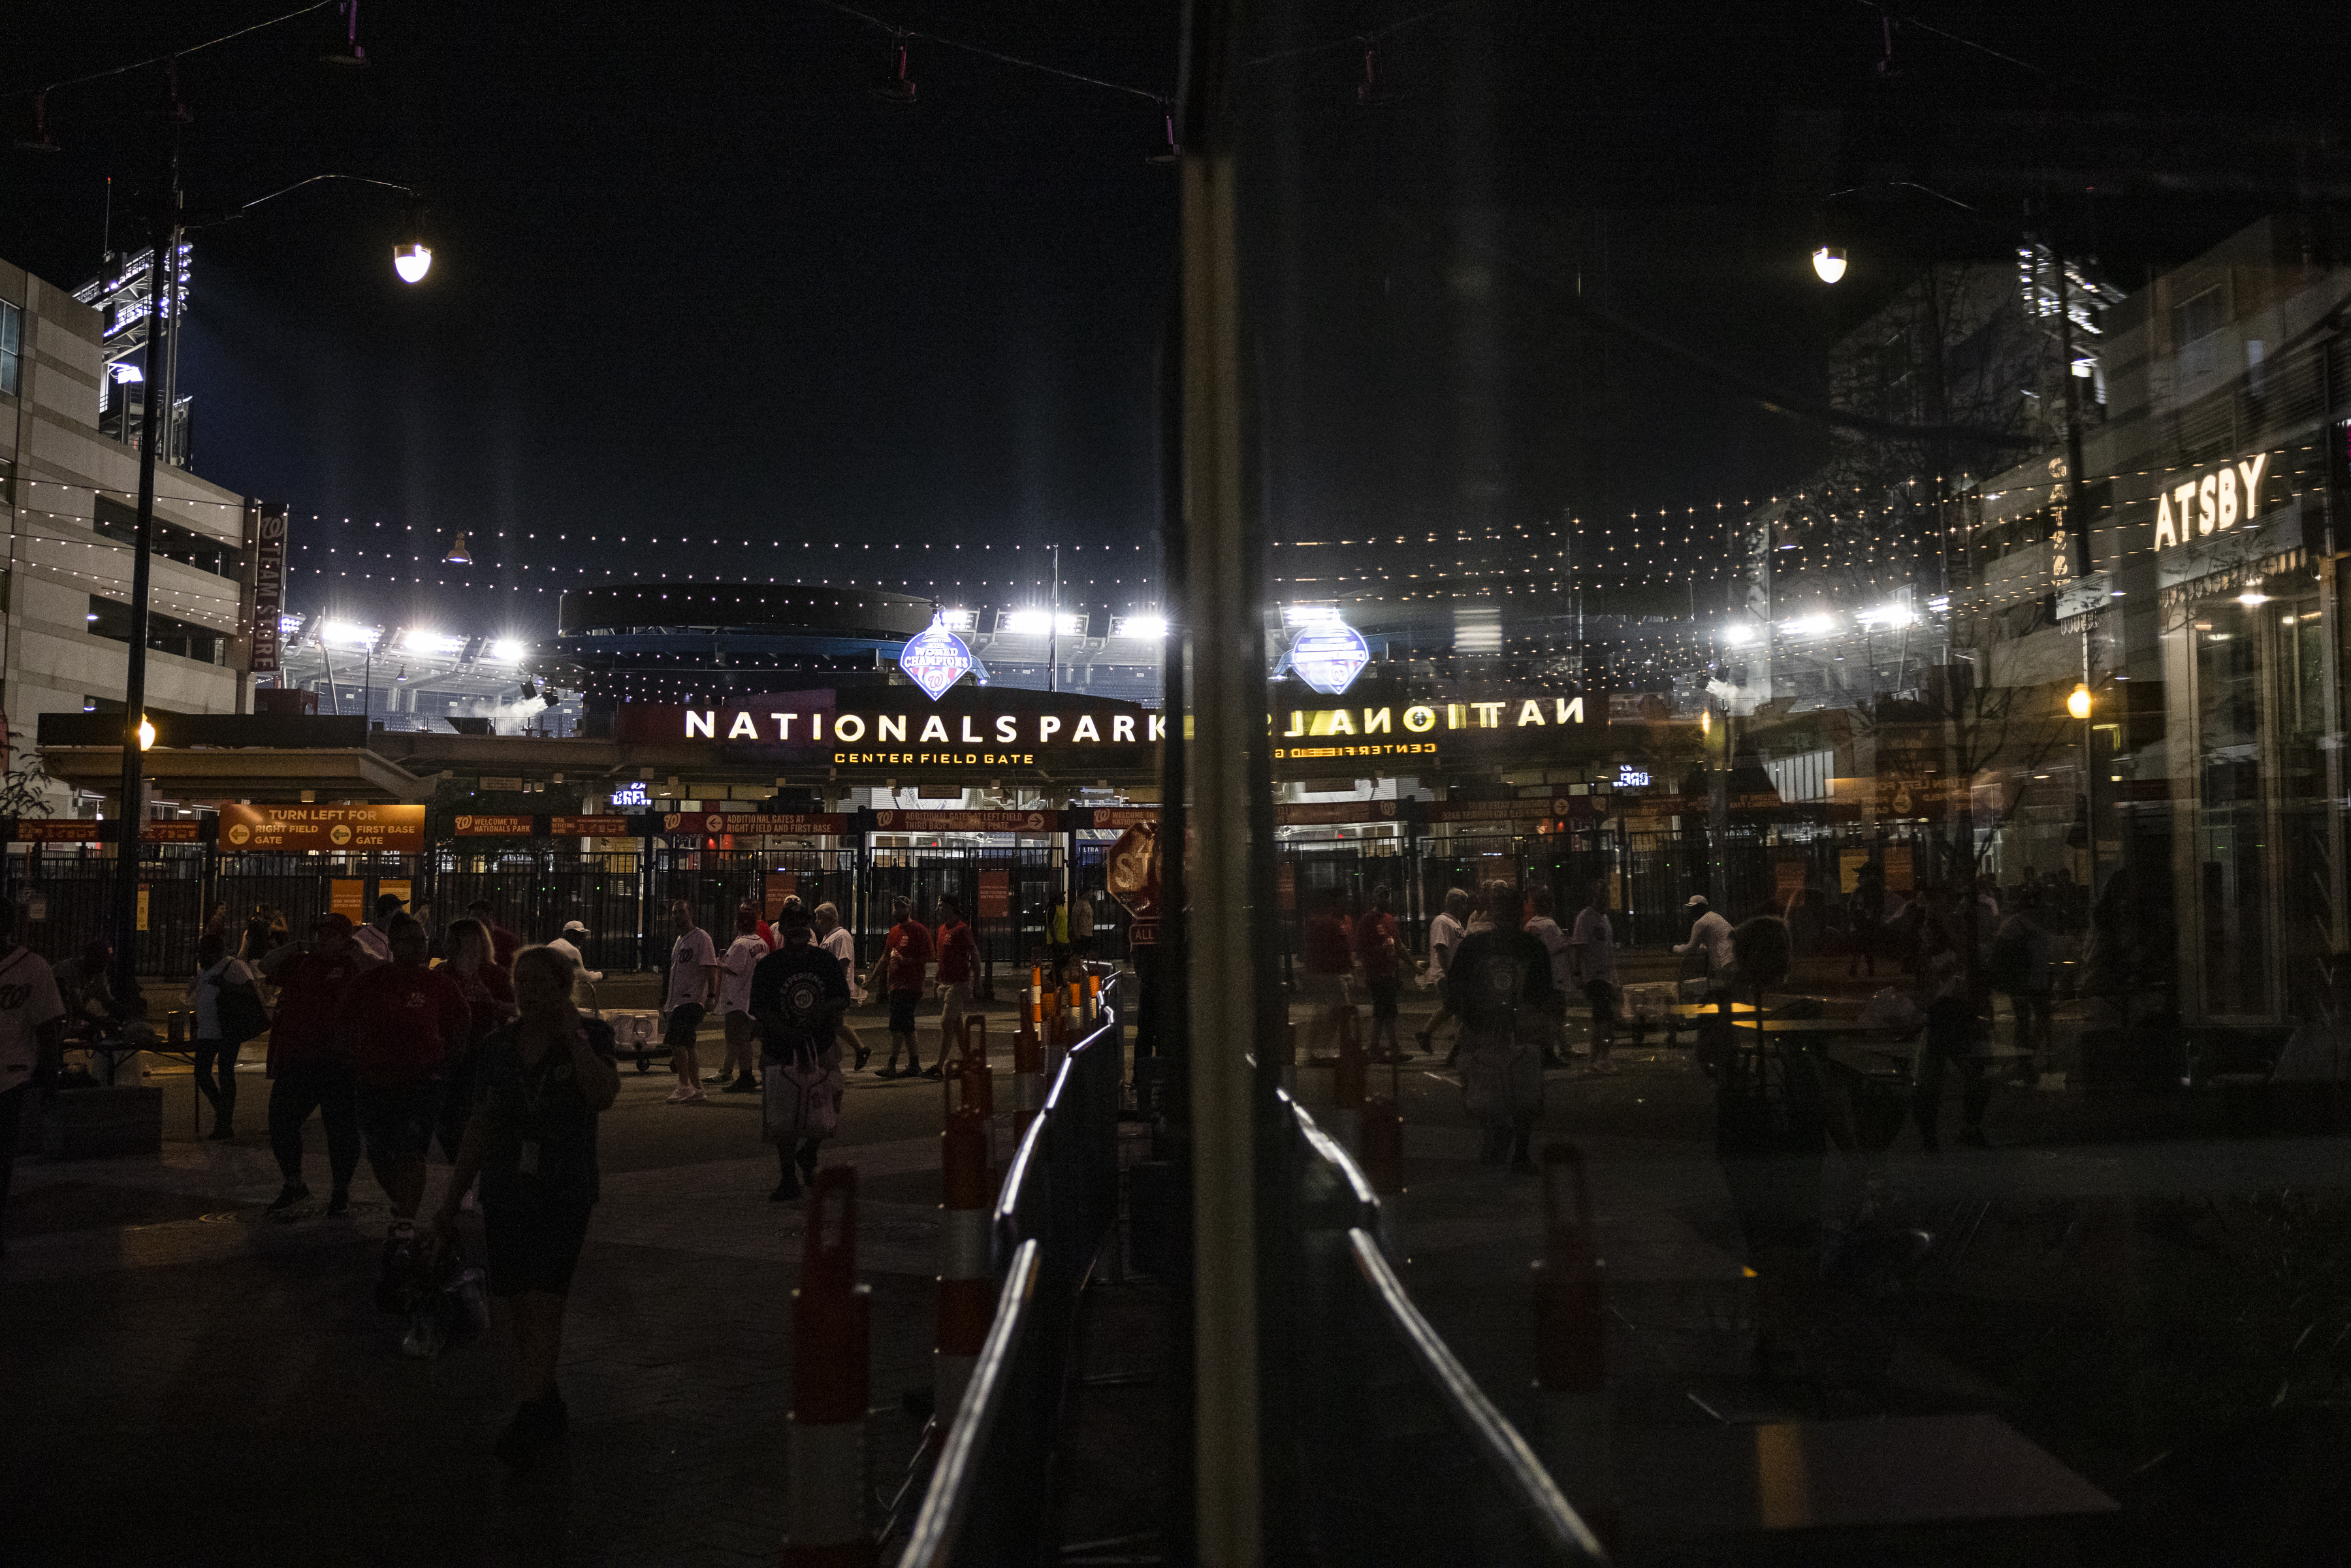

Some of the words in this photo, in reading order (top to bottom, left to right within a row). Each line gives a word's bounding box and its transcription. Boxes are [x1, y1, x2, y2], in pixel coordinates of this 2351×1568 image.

[2153, 453, 2265, 552] ATSBY
[2048, 458, 2071, 586] GATSB
[259, 546, 281, 597] TEAM
[255, 605, 277, 668] STORE
[914, 647, 958, 656] WORLD
[904, 656, 968, 668] CHAMPIONS
[686, 711, 1017, 743] NATIONALS
[1040, 715, 1166, 742] PARK
[835, 754, 913, 763] CENTER
[921, 754, 977, 765] FIELD
[984, 754, 1033, 765] GATE
[269, 810, 308, 820] TURN
[311, 810, 345, 820] LEFT
[349, 810, 377, 820] FOR
[727, 815, 770, 824] ADDITIONAL
[772, 815, 793, 824] GATES
[795, 815, 805, 824] AT
[905, 812, 948, 821] ADDITIONAL
[950, 812, 971, 821] GATES
[984, 812, 1000, 821] LEFT
[357, 825, 385, 834] FIRST
[388, 825, 415, 834] BASE
[727, 824, 748, 833] RIGHT
[750, 824, 771, 833] FIELD
[774, 824, 788, 833] AND
[790, 824, 811, 833] FIRST
[813, 824, 831, 833] BASE
[1115, 853, 1162, 888] ST
[1135, 929, 1155, 940] ALL
